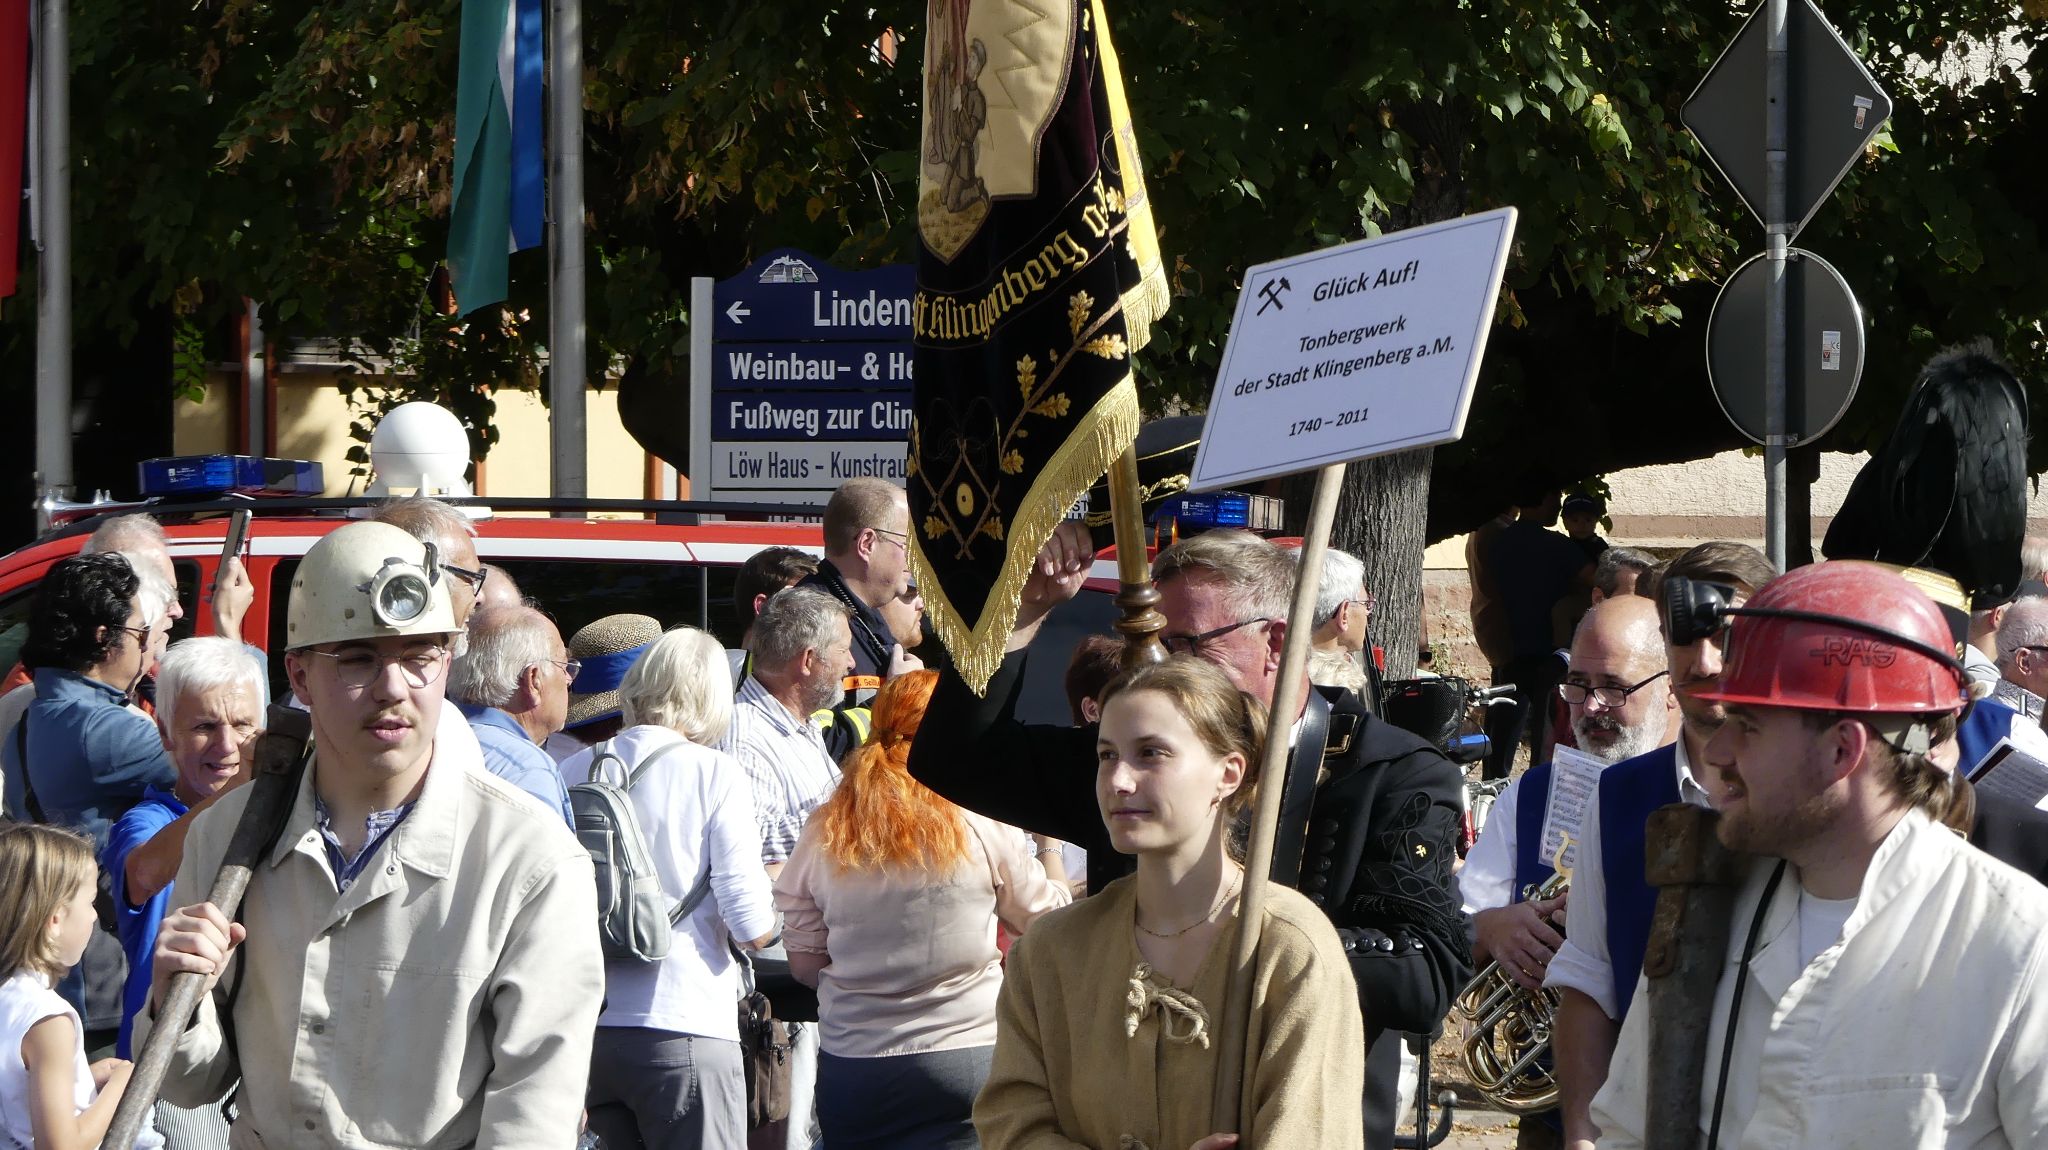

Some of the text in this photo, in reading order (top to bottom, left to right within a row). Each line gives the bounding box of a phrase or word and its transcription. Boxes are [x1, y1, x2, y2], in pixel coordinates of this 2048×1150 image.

[1312, 260, 1419, 302] Glück Auf!
[813, 289, 914, 327] Linden
[1299, 315, 1407, 352] Tonbergwerk
[729, 352, 851, 381] Weinbau-
[861, 352, 880, 381] &
[1234, 336, 1455, 397] der Stadt Klingenberg a.M.
[730, 401, 819, 437] Fußweg
[826, 408, 863, 430] zur
[1289, 417, 1322, 437] 1740
[1336, 407, 1369, 428] 2011
[729, 451, 762, 479] Löw
[768, 451, 809, 479] Haus
